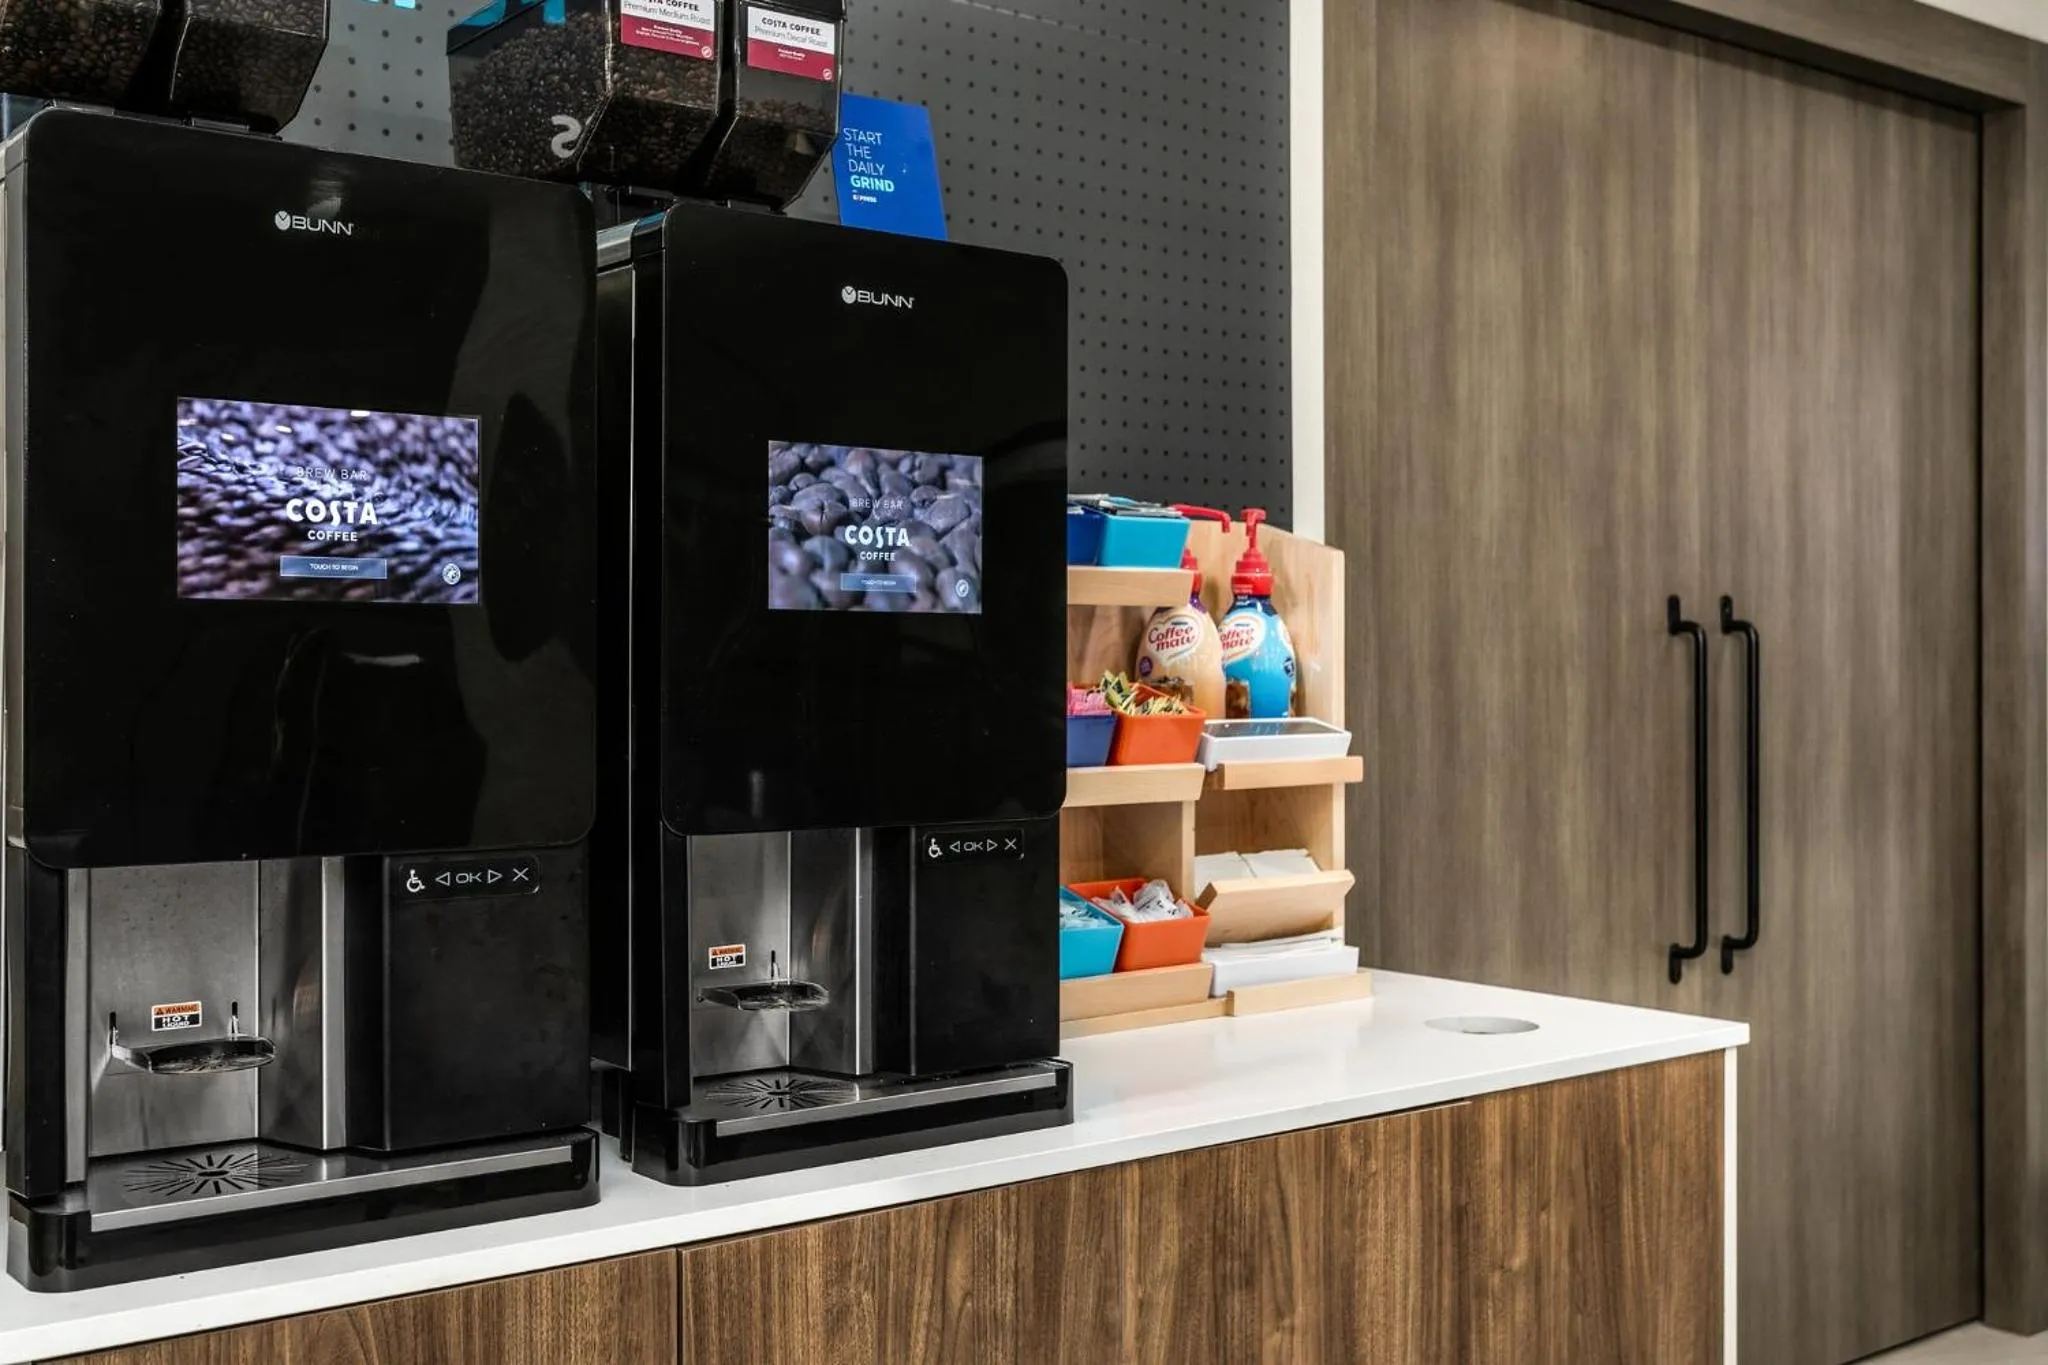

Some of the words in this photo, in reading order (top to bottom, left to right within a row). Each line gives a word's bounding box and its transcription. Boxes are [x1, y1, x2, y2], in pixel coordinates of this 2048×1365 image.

[624, 4, 658, 14] Premium
[667, 0, 700, 11] COFFEE
[761, 17, 787, 28] COSTA
[789, 22, 822, 35] COFFEE
[843, 128, 882, 144] START
[845, 143, 872, 159] THE
[848, 159, 885, 175] DAILY
[850, 175, 895, 192] GRIND
[296, 466, 336, 478] BREW
[340, 468, 368, 480] BAR
[286, 498, 378, 527] COSTA
[307, 530, 359, 541] COFFEE
[844, 524, 912, 549] COSTA
[860, 550, 896, 562] COFFEE
[1148, 626, 1193, 645] Coffee
[1220, 628, 1255, 643] offee
[1156, 635, 1195, 652] mate
[963, 841, 983, 852] OK
[455, 872, 482, 883] OK
[165, 1003, 198, 1014] WARNING
[162, 1015, 188, 1023] HOT
